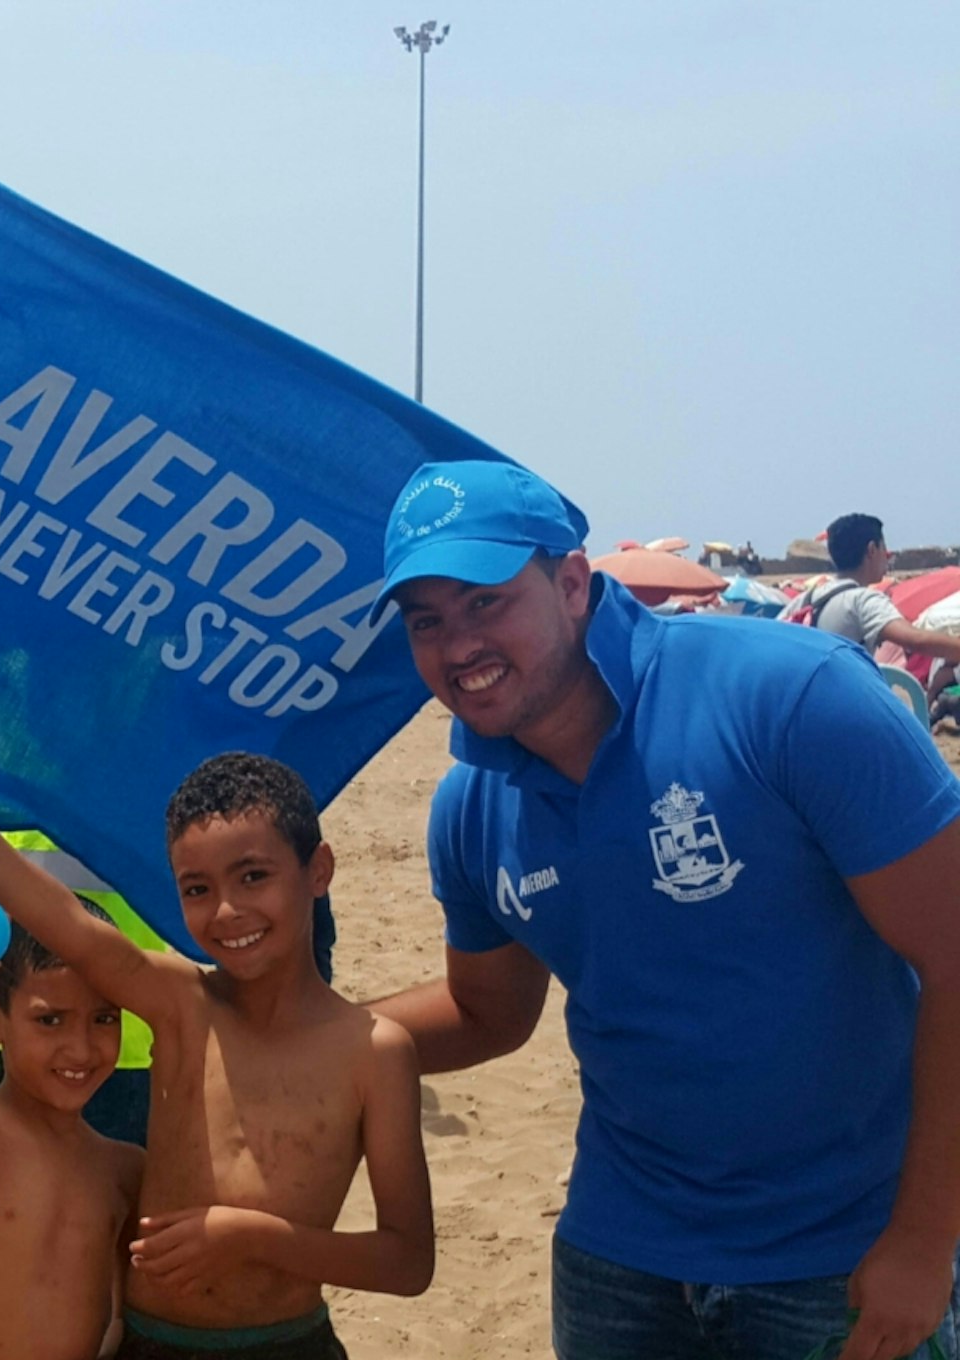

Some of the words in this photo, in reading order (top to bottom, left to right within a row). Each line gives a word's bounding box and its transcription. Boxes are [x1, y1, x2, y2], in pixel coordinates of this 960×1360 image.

[416, 525, 431, 537] de
[433, 501, 465, 529] Rabat
[161, 601, 338, 718] STOP
[519, 866, 559, 897] AVERDA
